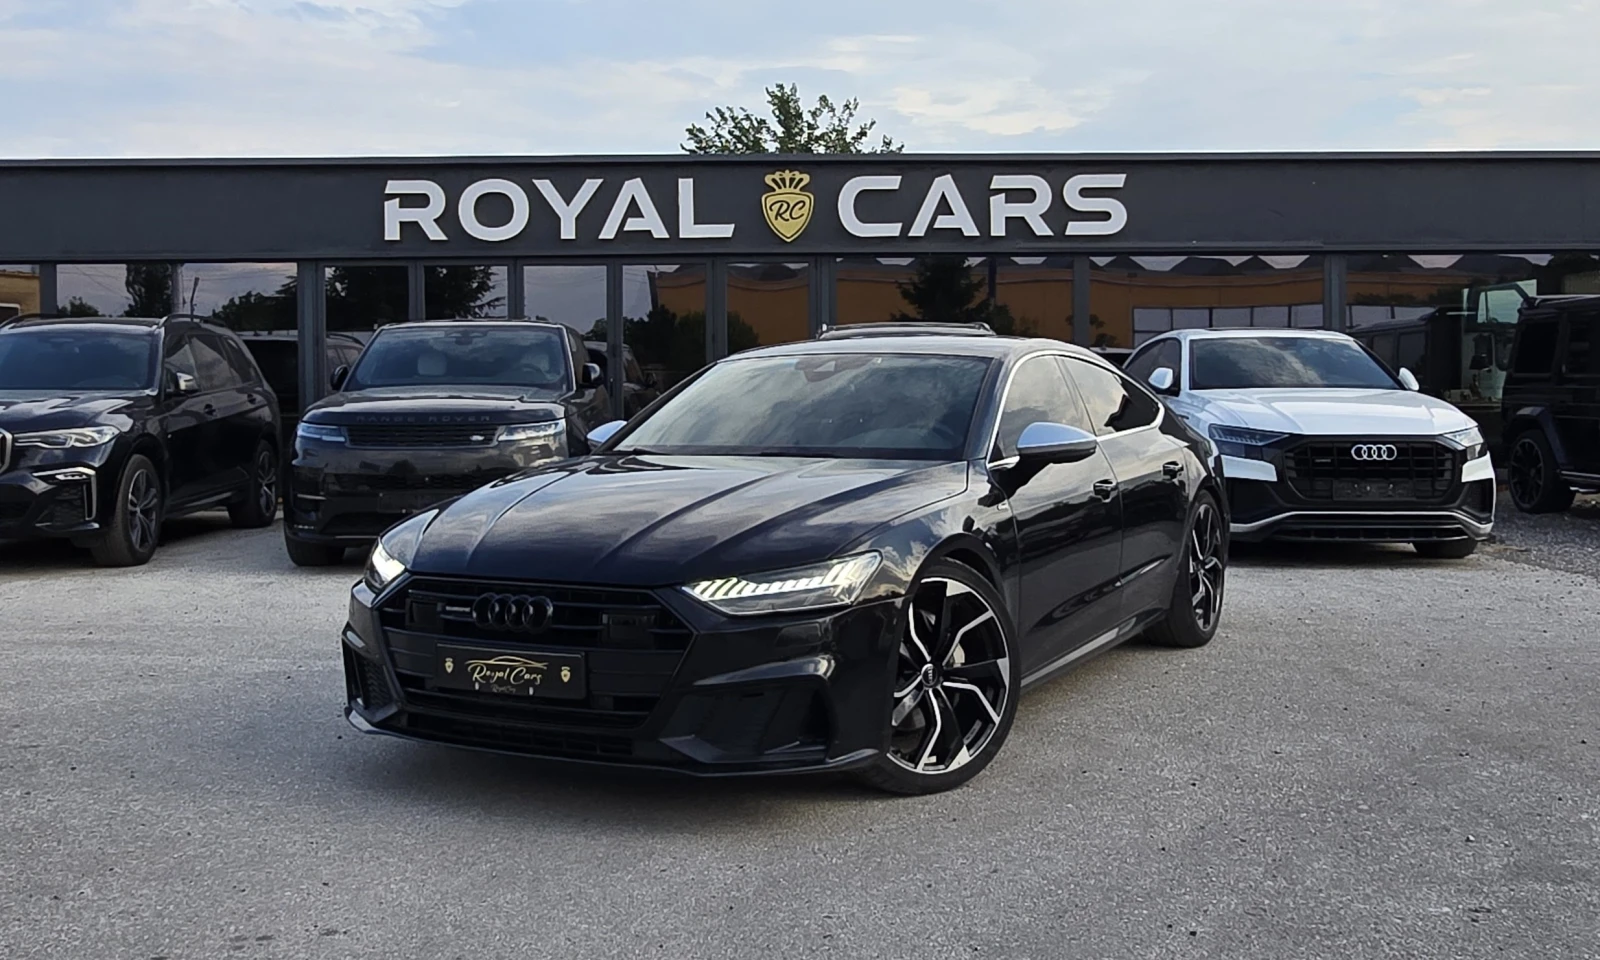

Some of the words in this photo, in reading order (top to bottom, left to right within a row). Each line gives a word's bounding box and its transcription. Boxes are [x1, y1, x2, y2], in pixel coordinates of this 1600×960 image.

[384, 177, 735, 242] ROYAL
[837, 173, 1128, 238] CARS
[769, 200, 806, 222] RC
[467, 663, 510, 683] Royal
[510, 666, 542, 685] Cars
